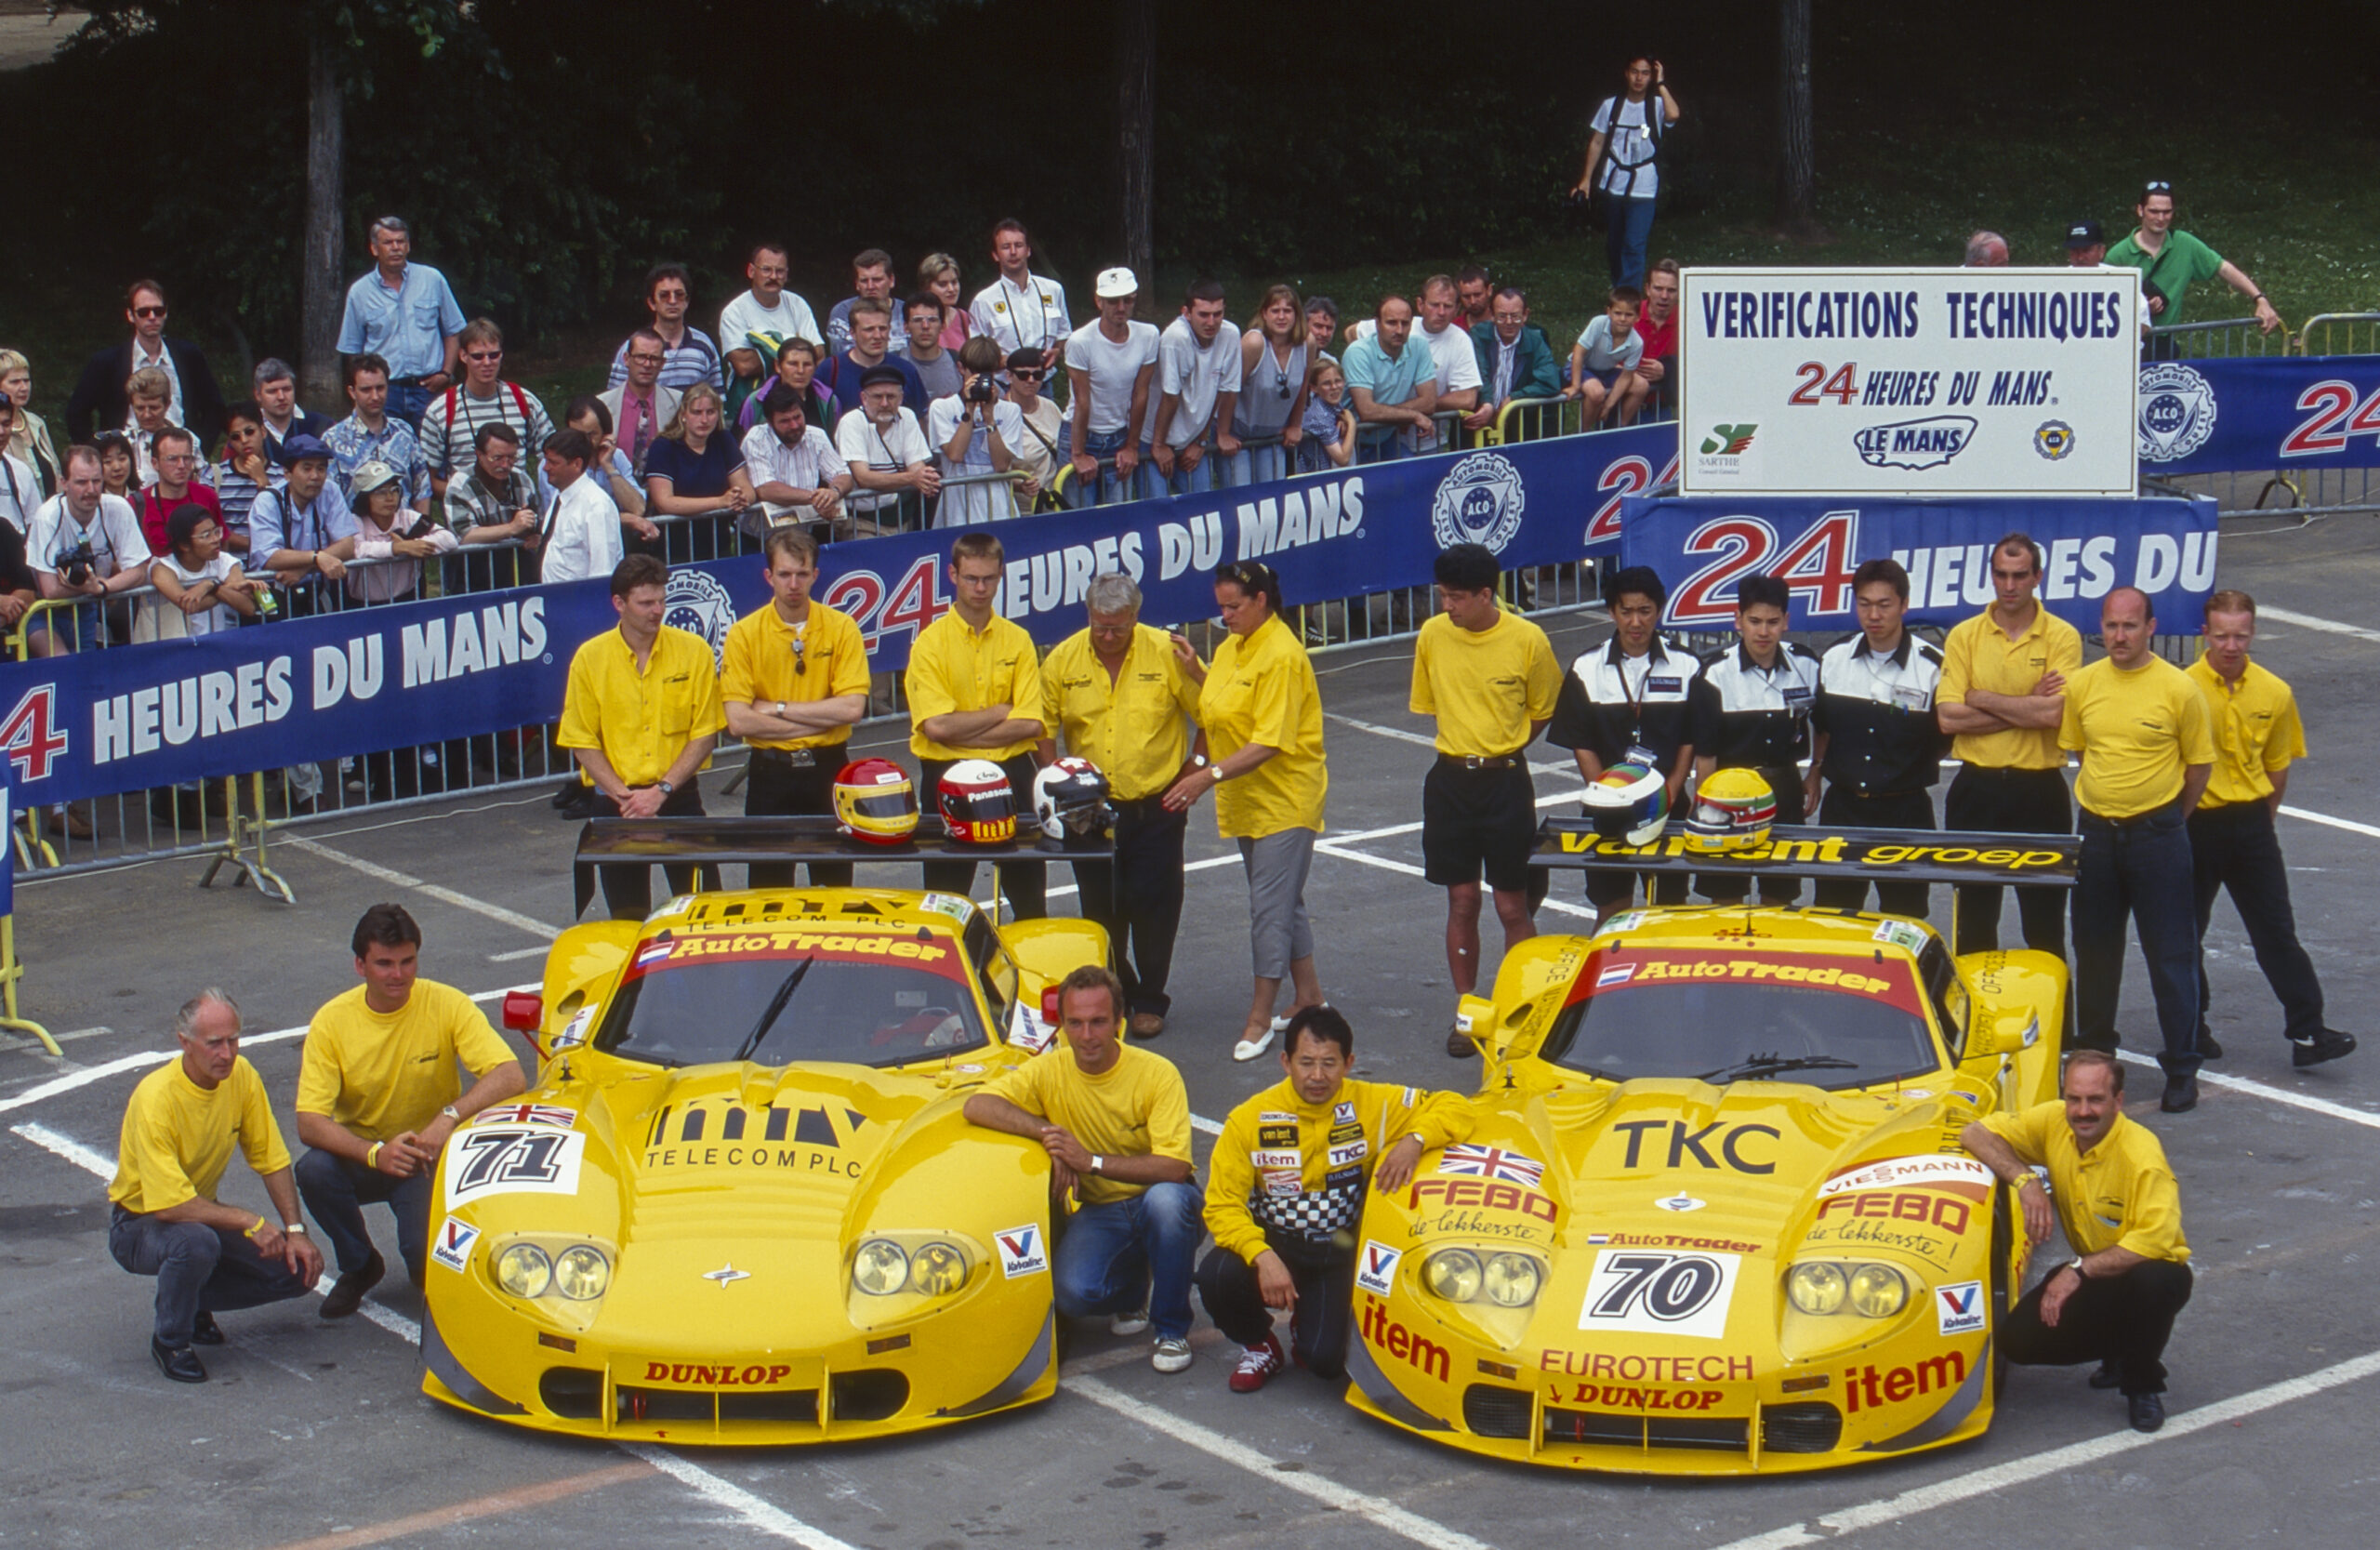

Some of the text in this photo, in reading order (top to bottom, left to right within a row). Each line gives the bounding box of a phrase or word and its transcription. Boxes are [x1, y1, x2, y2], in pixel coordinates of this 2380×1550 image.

[1702, 291, 2121, 343] VERIFICATIONS TECHNIQUES
[1788, 361, 2053, 405] 24 HEURES DU MANS
[1863, 428, 1962, 453] LE MANS
[1699, 457, 1739, 467] SARTHE
[823, 553, 951, 655] 24
[1158, 511, 1223, 581] DU
[1236, 477, 1364, 560] MANS
[1661, 510, 1858, 626] 24
[2134, 531, 2218, 594] DU
[94, 656, 293, 764] HEURES
[312, 632, 383, 710] DU
[403, 596, 548, 689] MANS
[1860, 841, 2064, 870] groep
[686, 914, 907, 933] TELECOM PLC
[668, 933, 947, 962] AutoTrader
[1634, 960, 1891, 994] AutoTrader
[455, 1129, 569, 1196] 71
[648, 1147, 862, 1179] TELECOM PLC
[1257, 1153, 1296, 1165] item
[1329, 1144, 1366, 1163] TKC
[1614, 1119, 1781, 1175] TKC
[1825, 1161, 1985, 1194] VIESSMANN
[1607, 1233, 1762, 1253] AutoTrader
[1006, 1257, 1043, 1273] Valvoline
[1589, 1253, 1724, 1322] 70
[1362, 1294, 1451, 1384] item
[1942, 1315, 1982, 1331] Valvoline
[643, 1361, 791, 1385] DUNLOP
[1540, 1348, 1754, 1382] EUROTECH
[1573, 1383, 1725, 1411] DUNLOP
[1844, 1351, 1965, 1413] item
